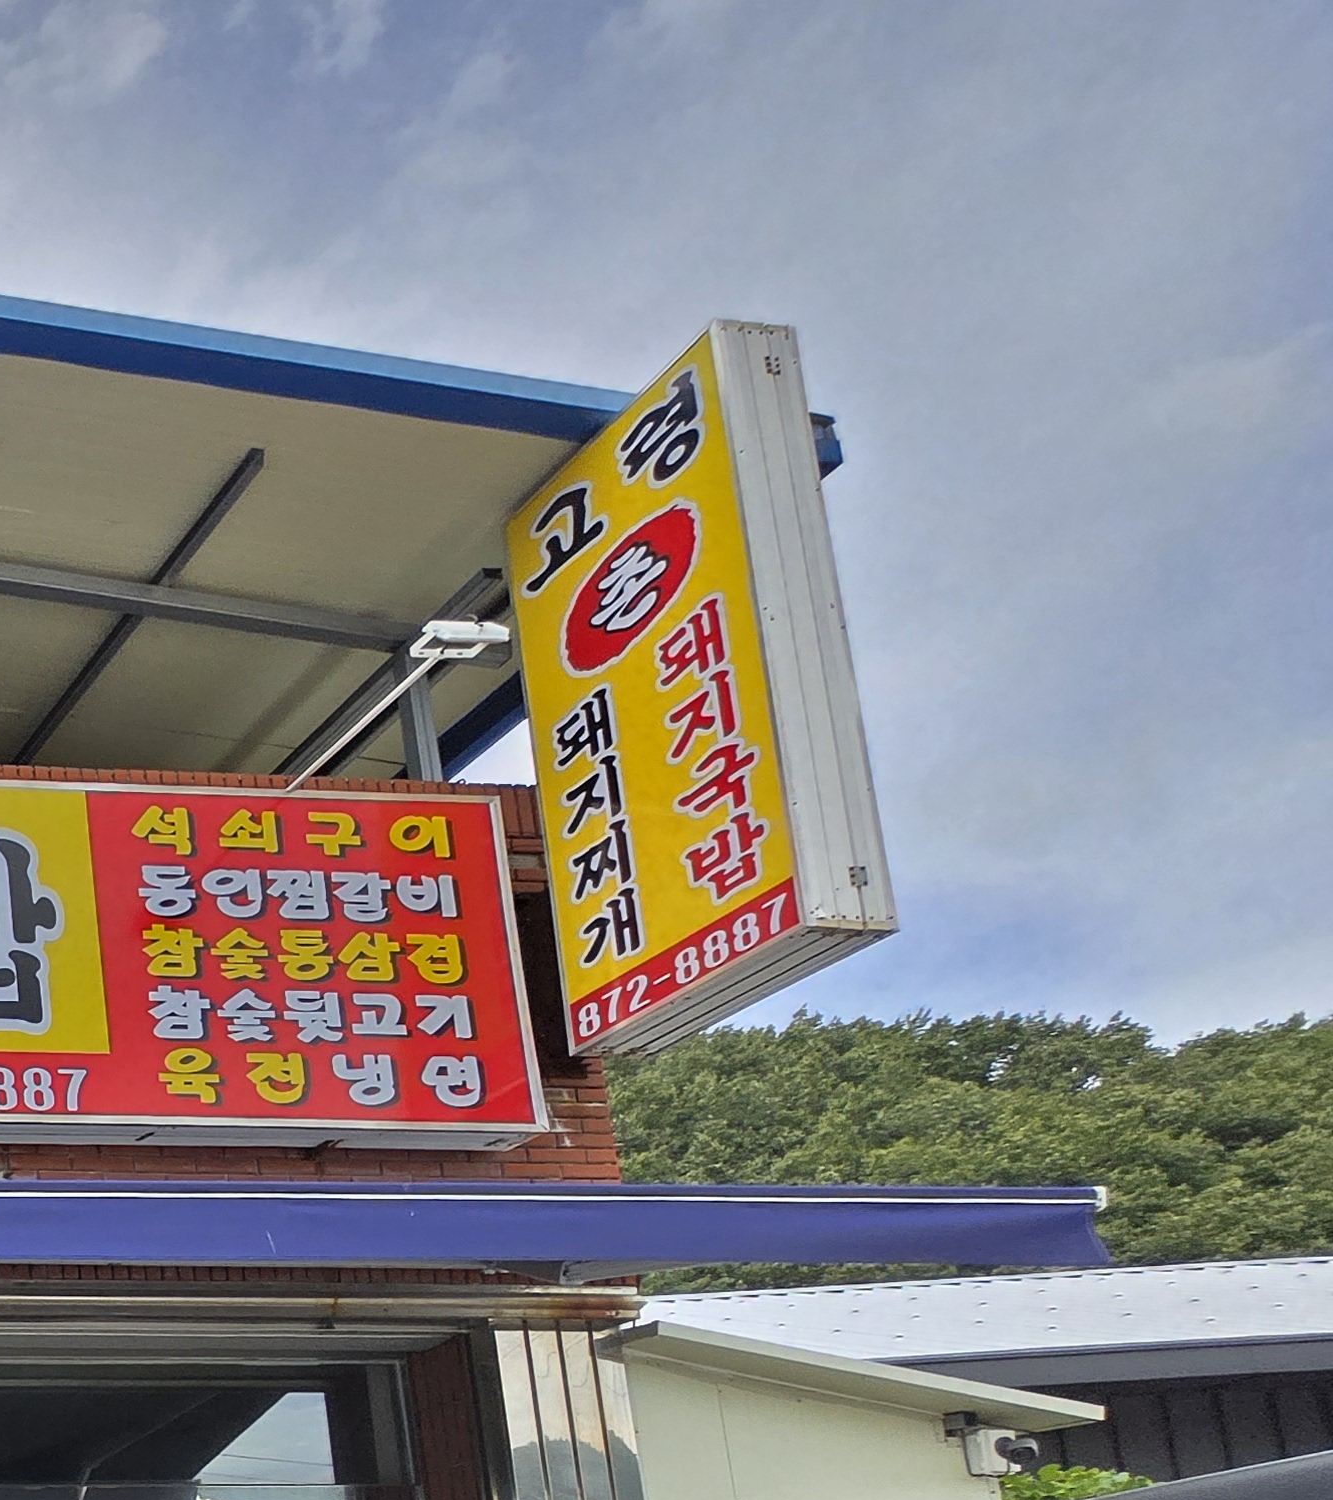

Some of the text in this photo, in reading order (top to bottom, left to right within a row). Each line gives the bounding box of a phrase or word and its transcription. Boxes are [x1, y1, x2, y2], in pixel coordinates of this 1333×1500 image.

[591, 540, 670, 632] 촌
[658, 592, 766, 906] 돼지국밥
[132, 804, 451, 858] 석쇠구이
[552, 685, 647, 968] 돼지찌개
[141, 924, 464, 984] 참숯통삼겹
[576, 890, 791, 1042] 872-8887
[147, 985, 474, 1044] 참숯뒷고기
